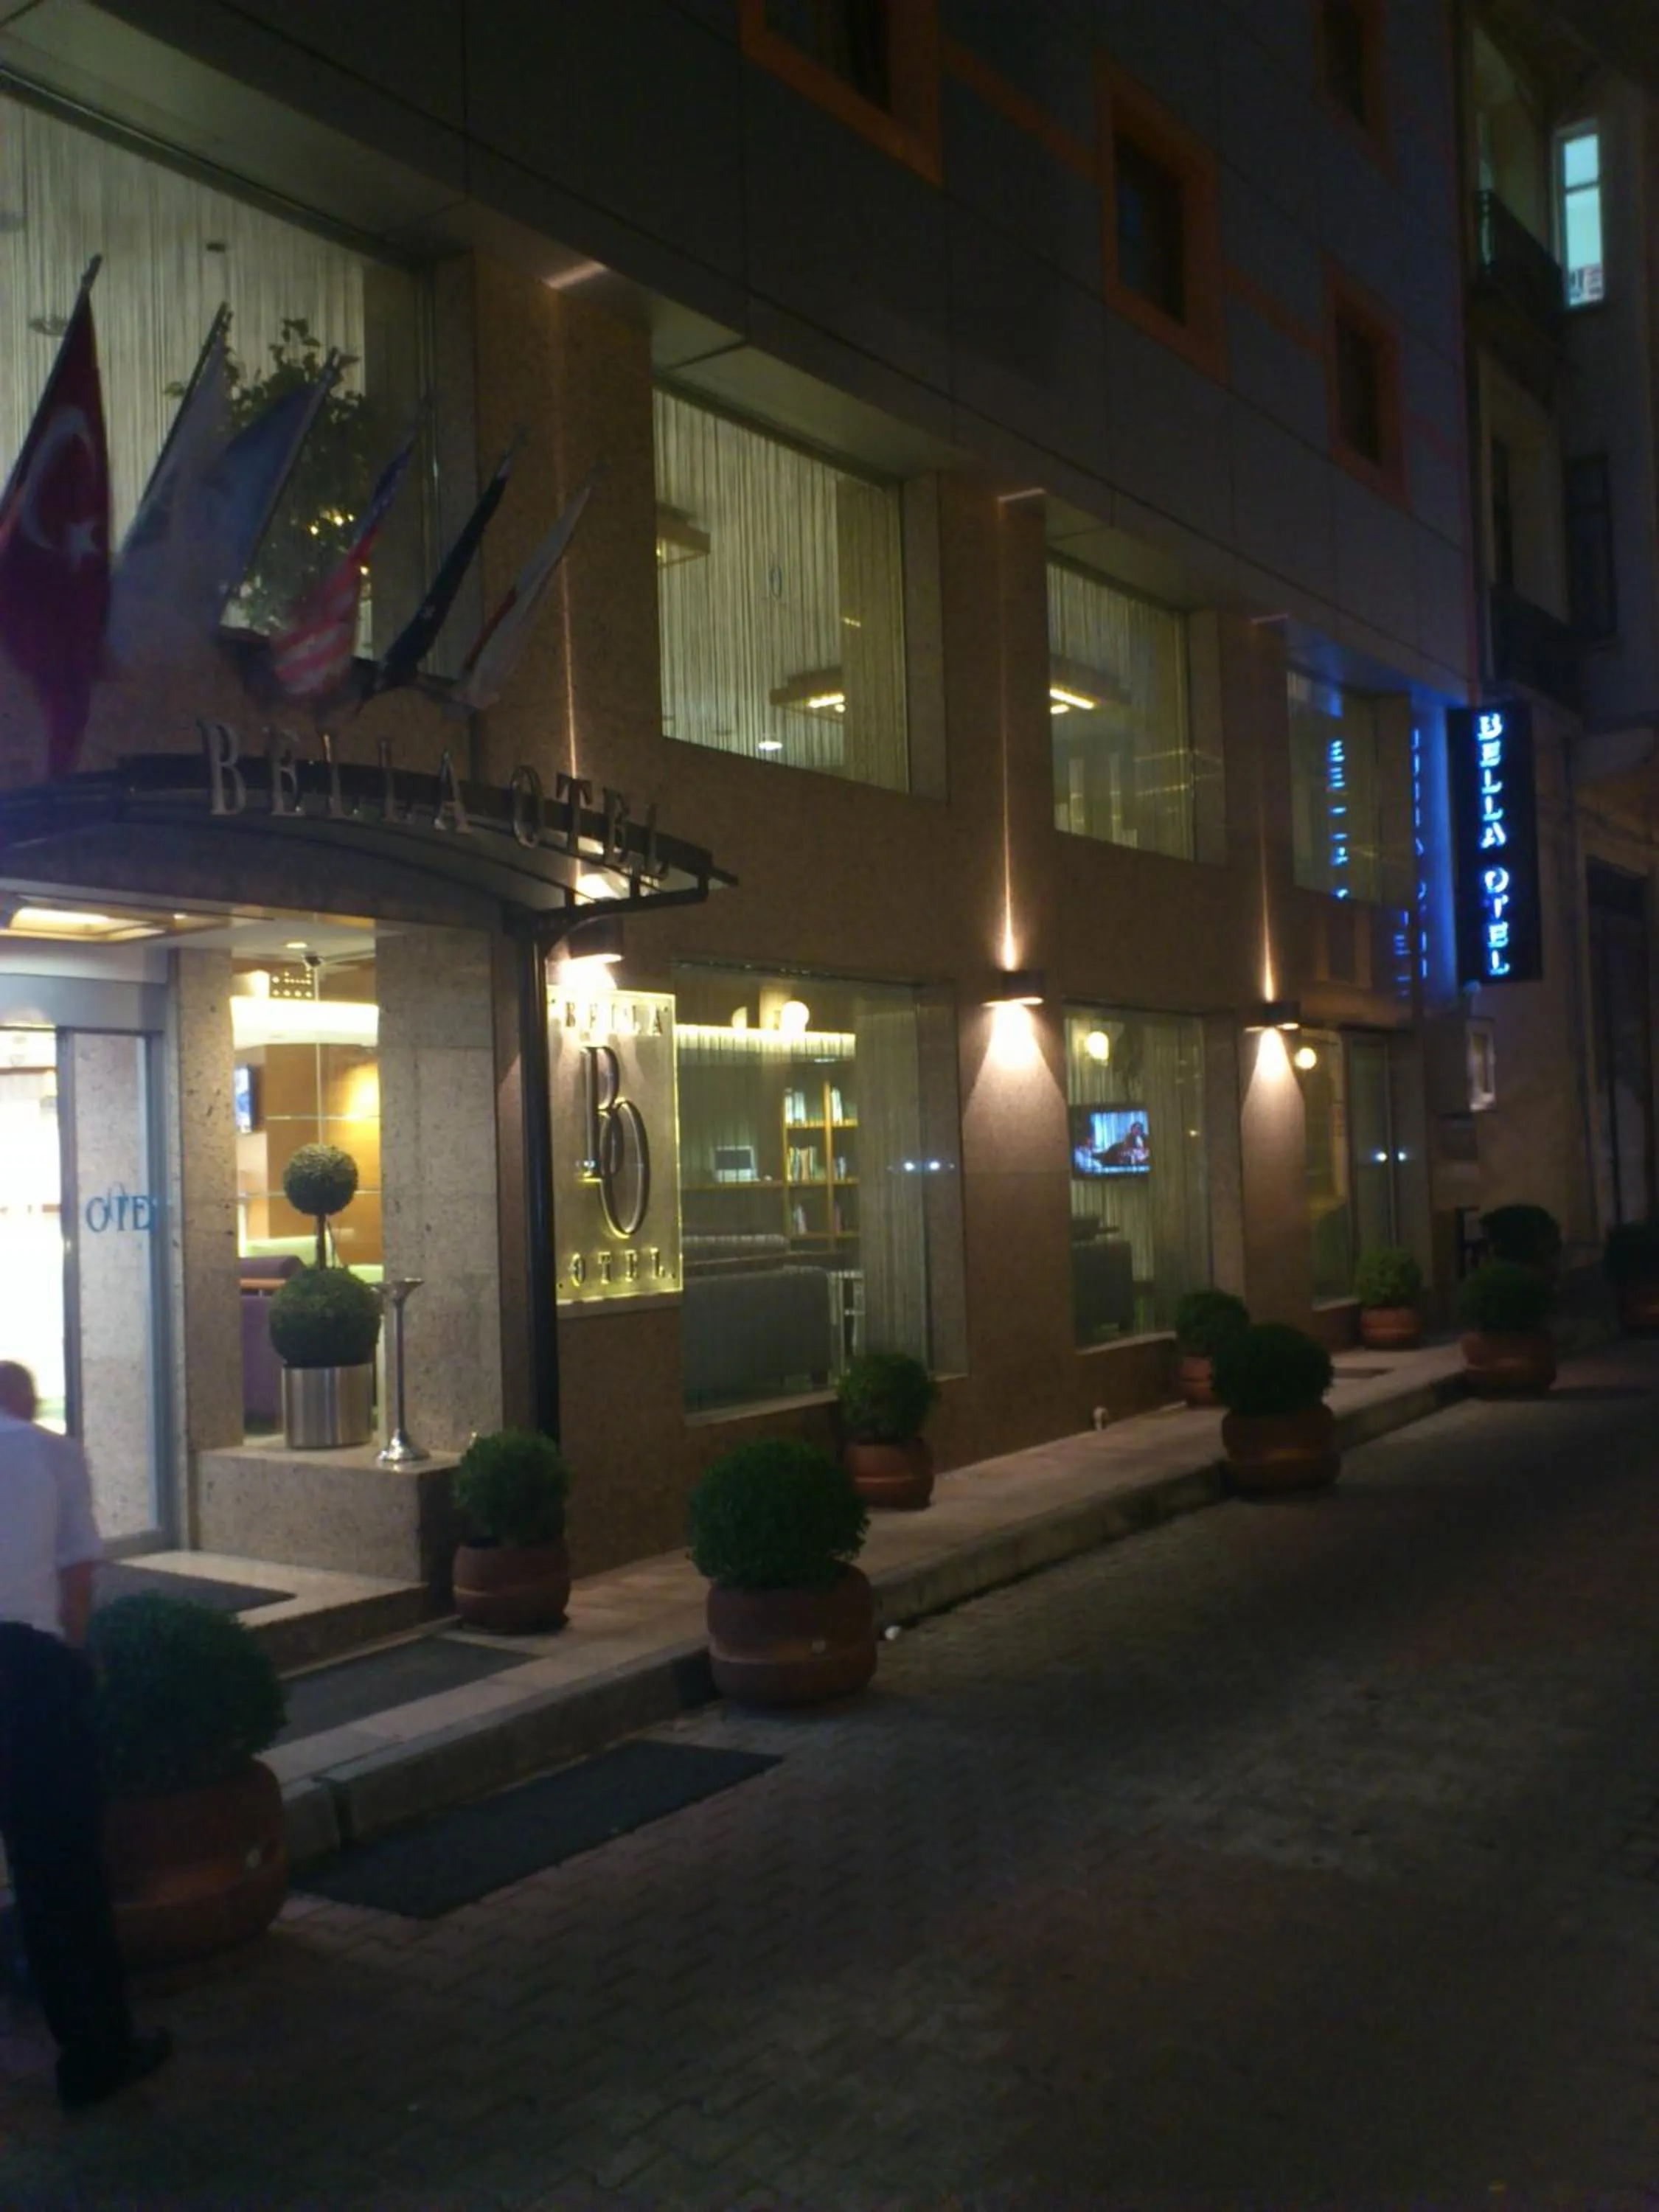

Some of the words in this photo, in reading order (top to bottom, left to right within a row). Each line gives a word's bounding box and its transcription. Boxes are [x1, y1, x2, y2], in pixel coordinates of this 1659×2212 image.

[195, 718, 473, 835] BELLA
[509, 764, 669, 882] OTEL
[1477, 712, 1506, 849] BELLA
[1484, 868, 1510, 976] OTEL
[569, 1248, 665, 1287] OTEL
